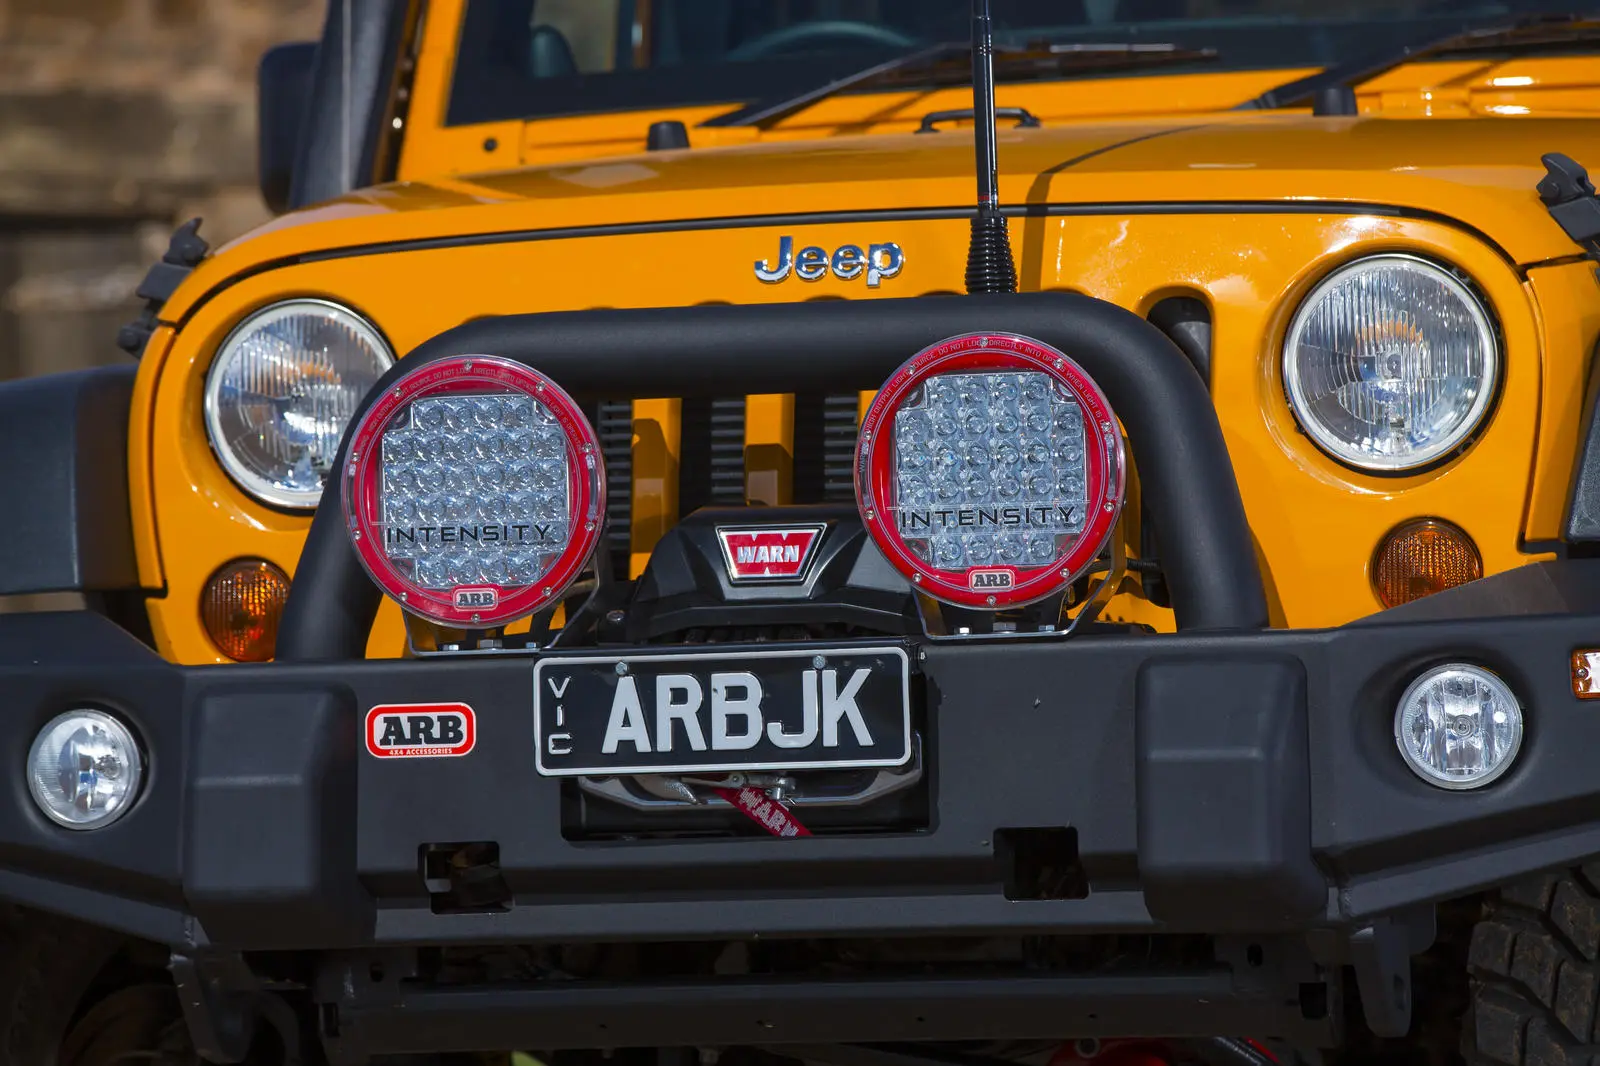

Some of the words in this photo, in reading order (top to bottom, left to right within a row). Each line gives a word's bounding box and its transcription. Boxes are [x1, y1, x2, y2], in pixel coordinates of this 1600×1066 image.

[754, 236, 905, 288] Jeep
[910, 351, 936, 372] OURCE.
[949, 342, 965, 351] NOT
[988, 339, 1024, 350] DIRECTLY
[1025, 347, 1042, 357] INTO
[1066, 371, 1085, 390] WHEN
[901, 506, 1075, 528] INTENSITY
[387, 524, 551, 543] INTENSITY
[737, 545, 799, 563] WARN
[974, 573, 1011, 588] ARB
[457, 592, 494, 607] ARB
[601, 668, 876, 754] ARBJK
[380, 715, 464, 746] ARB
